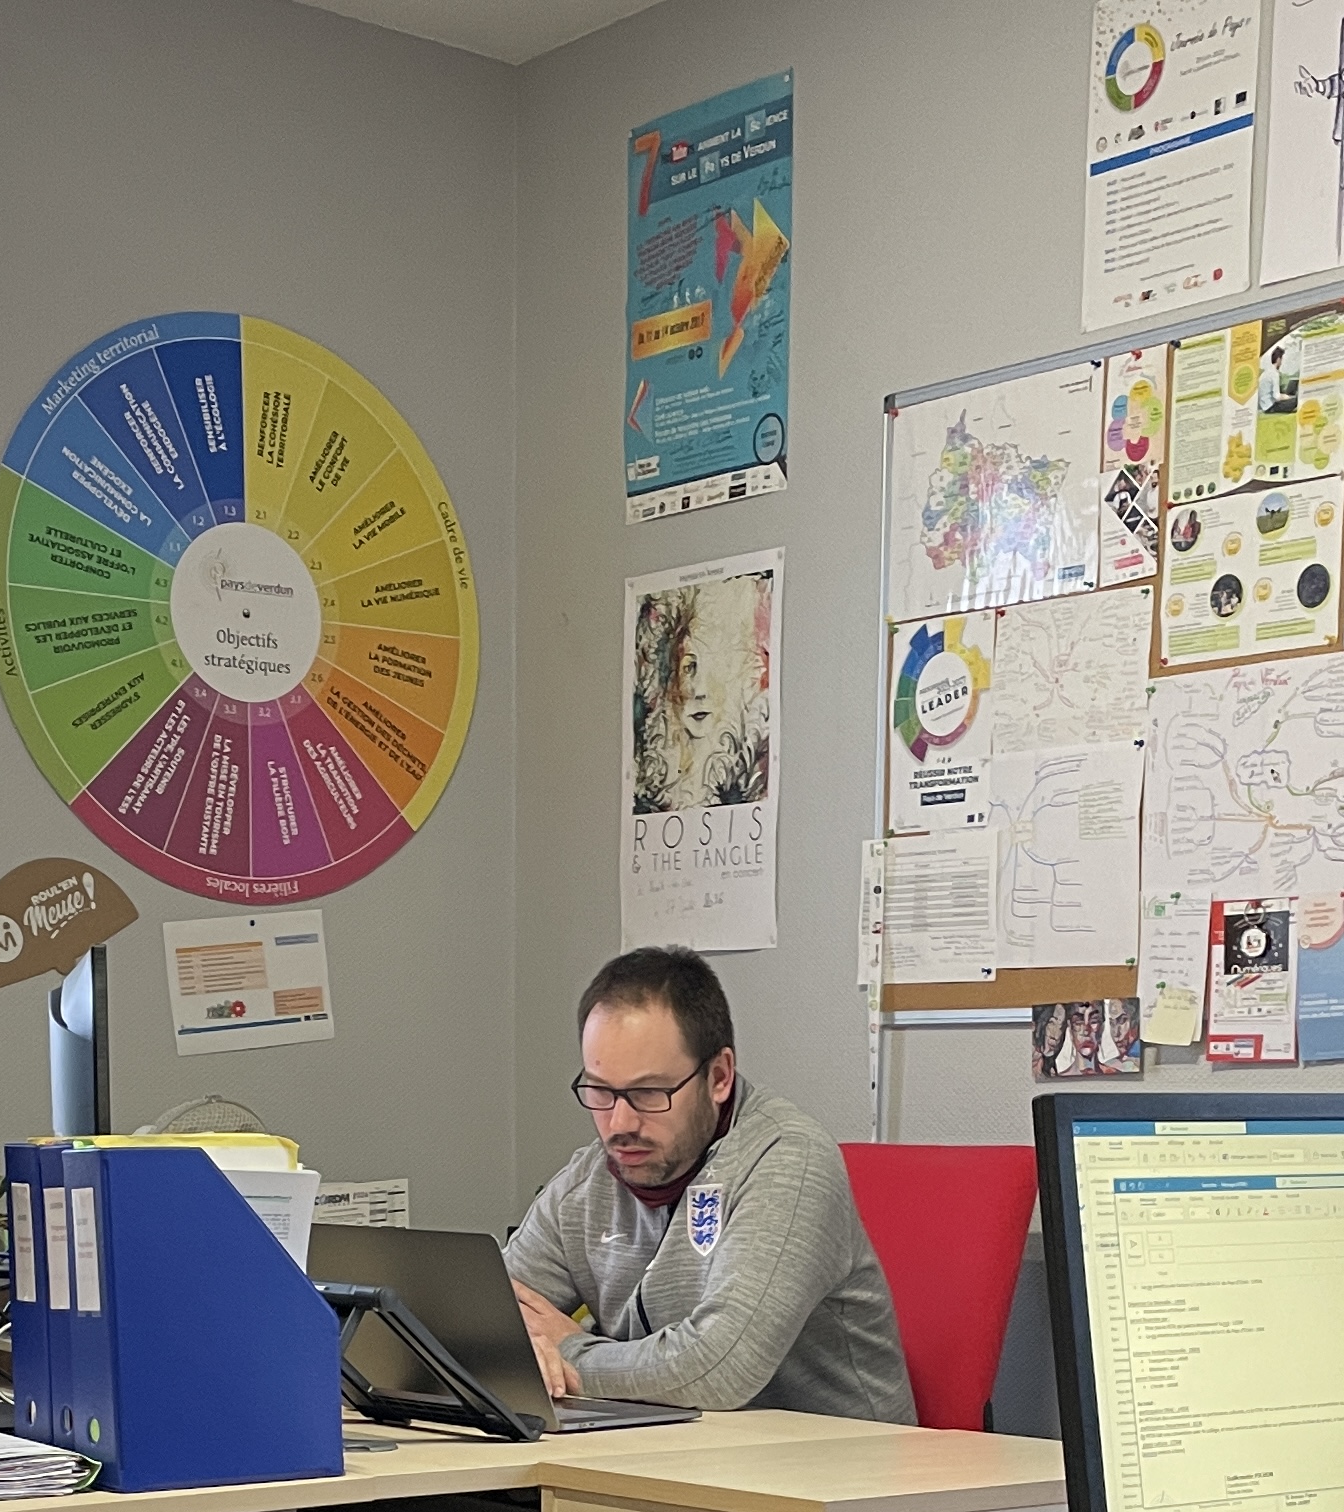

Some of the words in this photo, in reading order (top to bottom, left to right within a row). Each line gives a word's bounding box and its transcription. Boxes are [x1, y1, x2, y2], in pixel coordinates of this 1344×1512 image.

[41, 352, 101, 416] Marketing
[97, 323, 160, 362] territorial
[119, 383, 175, 474] COMMUNICATION
[194, 377, 218, 453] SENSIBILISER
[256, 391, 271, 458] RENFORCER
[267, 391, 282, 447] COHÉSION
[123, 411, 164, 475] RENFORCER
[276, 393, 292, 469] TERRITORIALE
[266, 448, 276, 465] LA
[308, 430, 340, 484] AMÉLIORER
[315, 479, 325, 493] LE
[322, 436, 349, 481] CONFORT
[61, 446, 138, 515] COMMUNICATION
[172, 474, 185, 491] LA
[330, 473, 341, 488] DE
[338, 456, 351, 477] VIE
[72, 470, 131, 524] DÉVELOPPER
[139, 513, 152, 527] LA
[352, 500, 397, 536] AMÉLIORER
[352, 538, 366, 550] LA
[364, 527, 378, 542] VIE
[376, 506, 407, 532] MOBILE
[437, 501, 459, 543] Cadre
[28, 532, 93, 561] ASSOCIATIVE
[45, 525, 109, 555] CULTURELLE
[109, 548, 122, 558] ET
[49, 553, 111, 580] CONFORTER
[95, 555, 136, 576] L'OFFRE
[453, 547, 465, 565] de
[374, 578, 423, 594] AMÉLIORER
[457, 568, 469, 590] vie
[91, 608, 138, 624] SERVICES
[360, 598, 375, 608] LA
[375, 596, 389, 606] VIE
[24, 618, 68, 632] PUBLICS
[68, 615, 90, 626] AUX
[120, 621, 133, 632] ET
[34, 632, 54, 644] LES
[52, 636, 121, 654] PROMOUVOIR
[216, 627, 279, 650] Objectifs
[204, 653, 291, 677] stratégiques
[368, 651, 380, 662] LA
[380, 654, 433, 679] FORMATION
[376, 643, 427, 666] AMÉLIORER
[125, 671, 145, 690] AUX
[373, 665, 391, 677] DES
[390, 669, 426, 688] JEUNES
[71, 685, 129, 729] ENTREPRISES
[90, 691, 141, 731] S'ADRESSER
[174, 699, 186, 715] ET
[330, 685, 342, 697] LA
[340, 693, 376, 729] GESTION
[375, 725, 393, 742] DES
[921, 686, 968, 714] LEADER
[164, 711, 180, 732] LES
[176, 714, 191, 733] LES
[326, 695, 339, 709] DE
[377, 740, 391, 753] ET
[388, 750, 402, 763] DE
[362, 700, 407, 741] AMÉLIORER
[140, 730, 168, 774] ACTEURS
[212, 734, 222, 752] DE
[223, 739, 233, 754] LA
[155, 746, 186, 796] SOUTENIR
[206, 751, 221, 796] L'OFFRE
[219, 754, 231, 781] MISE
[315, 743, 329, 759] LA
[323, 754, 360, 815] TRANSITION
[328, 745, 363, 800] AMÉLIORER
[131, 773, 146, 793] DE
[131, 753, 170, 815] L'ARTISANAT
[216, 782, 227, 799] EN
[302, 739, 318, 760] DES
[314, 760, 357, 830] AGRICULTEURS
[909, 775, 979, 790] TRANSFORMATION
[267, 760, 277, 776] LA
[278, 817, 291, 845] BOIS
[278, 766, 299, 836] STRUCTURER
[198, 797, 216, 855] EXISTANTE
[208, 799, 225, 856] TOURISME
[633, 806, 763, 851] ROSIS
[632, 854, 642, 875] &
[652, 850, 682, 872] THE
[693, 844, 764, 868] TANGLE
[30, 875, 79, 905] ROUL'EN
[206, 876, 250, 898] locales
[252, 880, 299, 897] Filières
